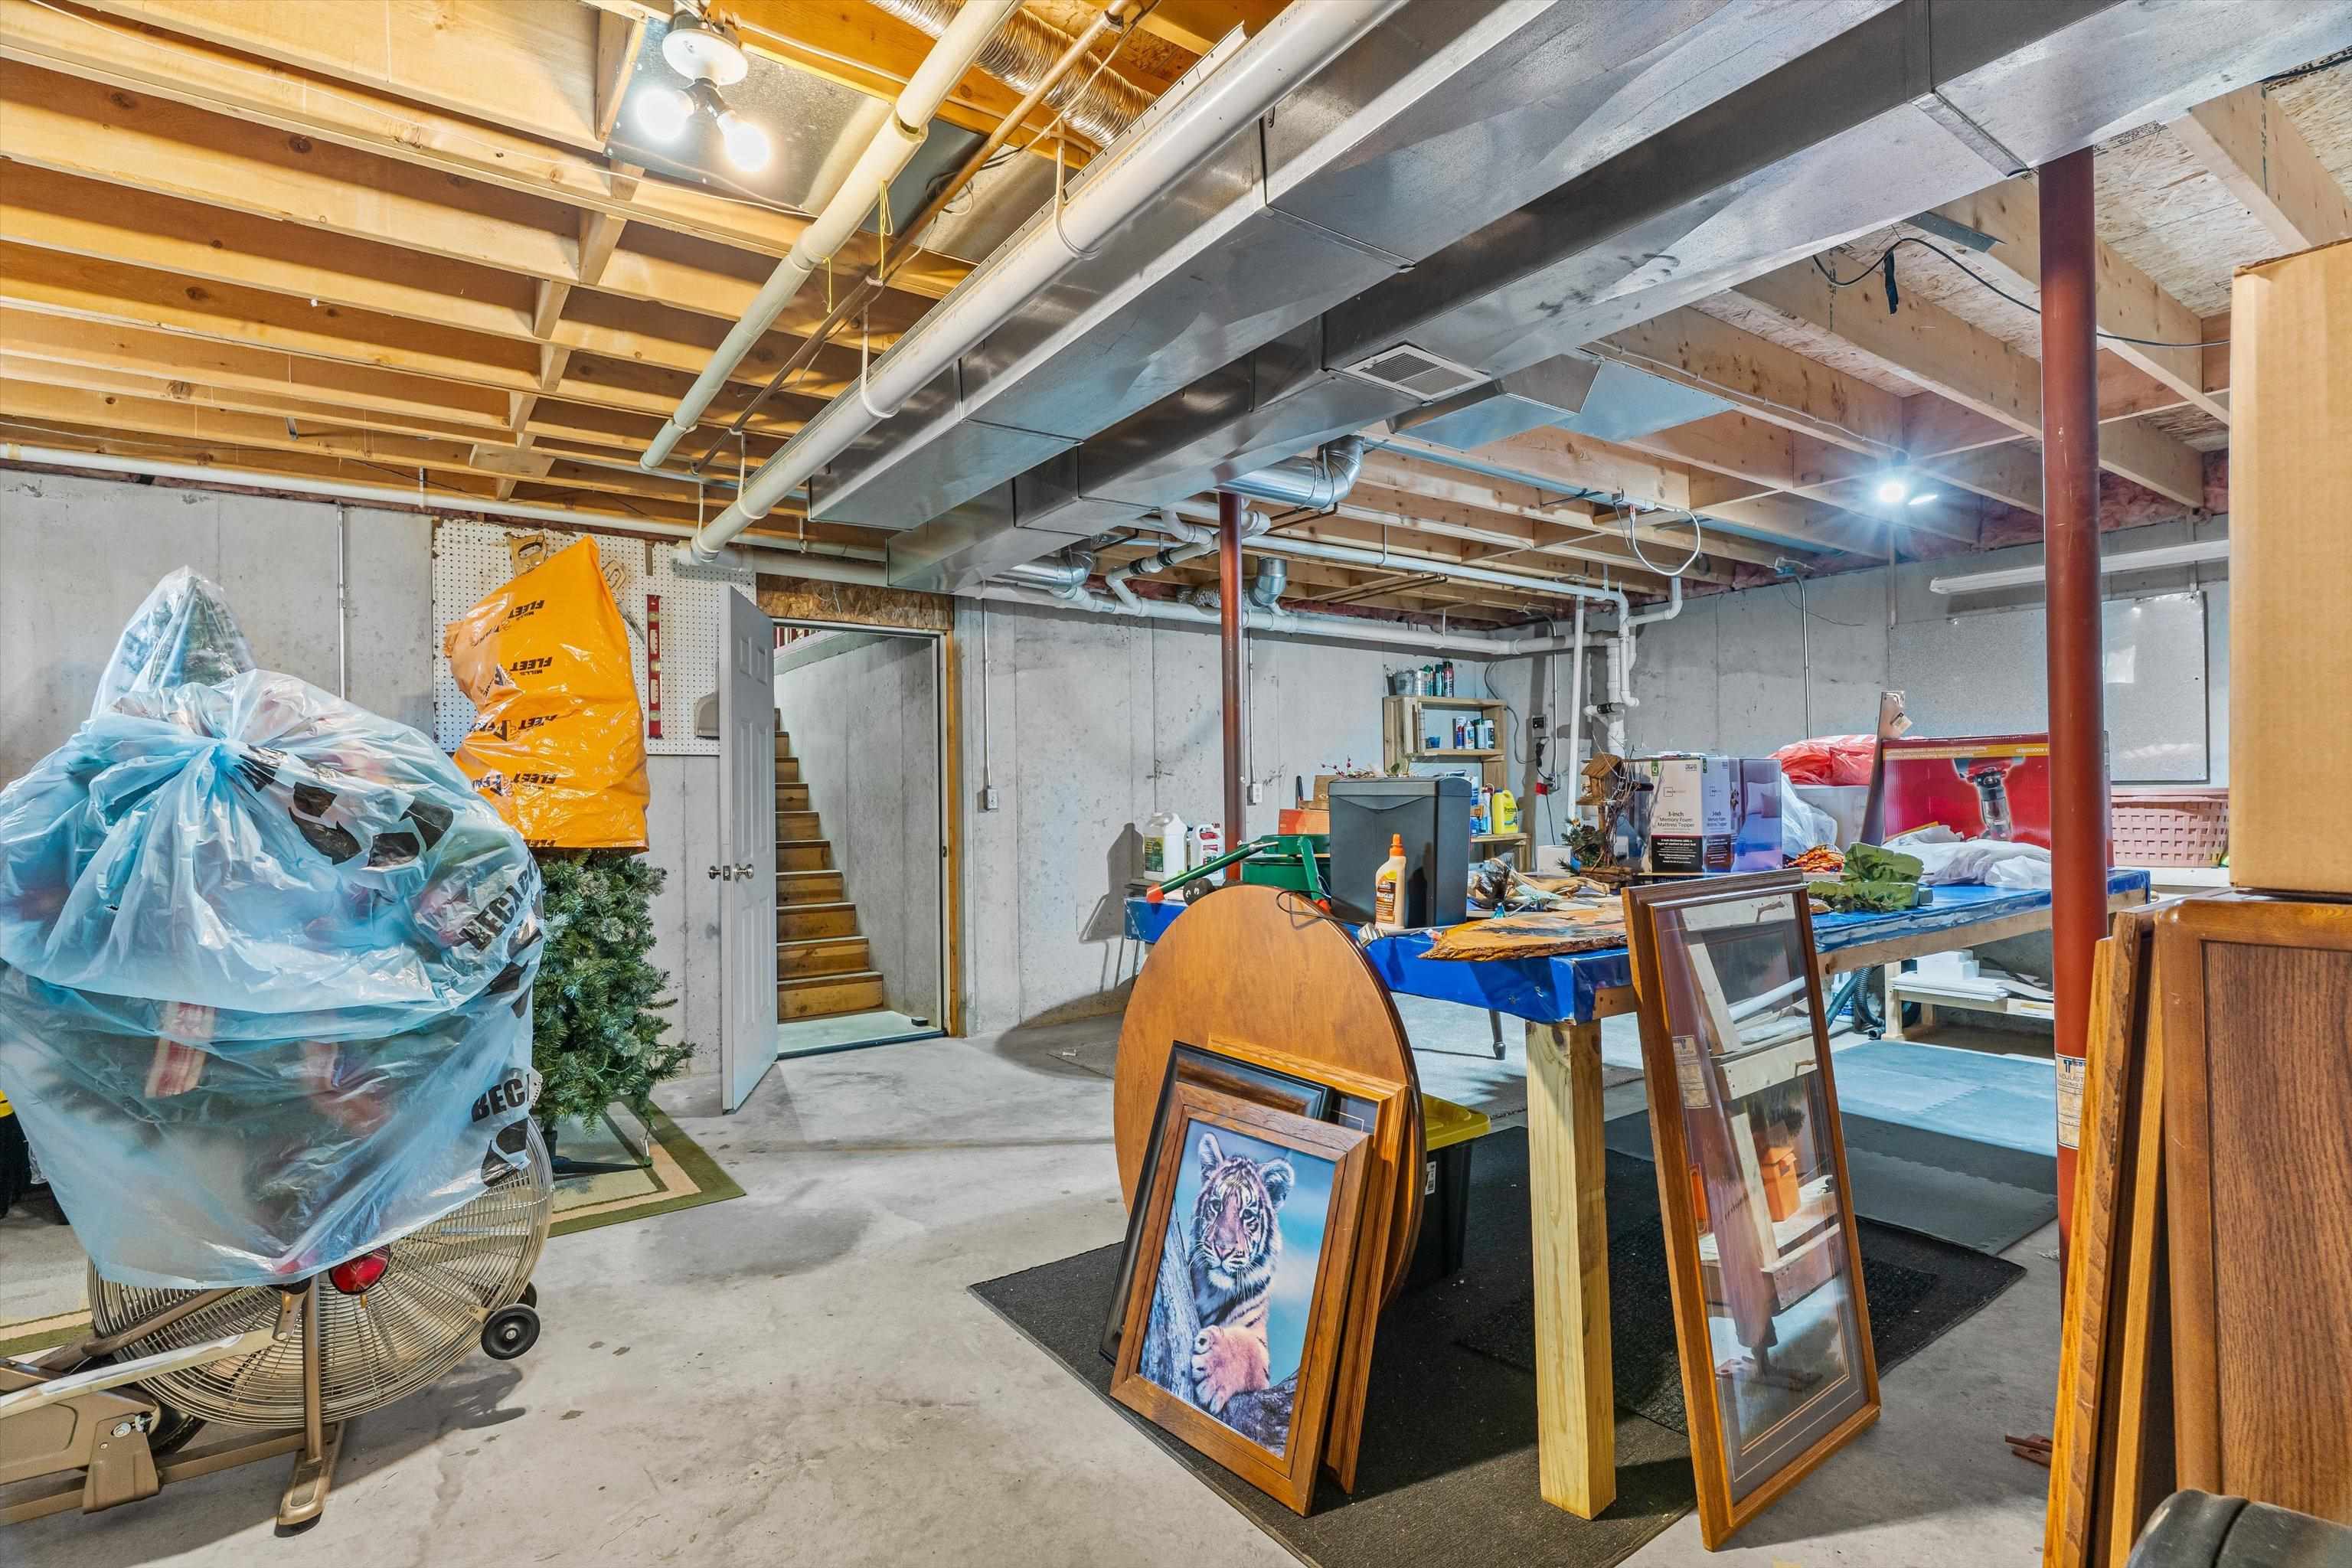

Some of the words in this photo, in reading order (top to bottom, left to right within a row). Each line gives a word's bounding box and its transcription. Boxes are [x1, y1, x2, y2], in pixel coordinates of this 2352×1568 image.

[508, 600, 545, 619] FLEET
[510, 657, 553, 671] FLEET
[512, 773, 557, 785] FLEET
